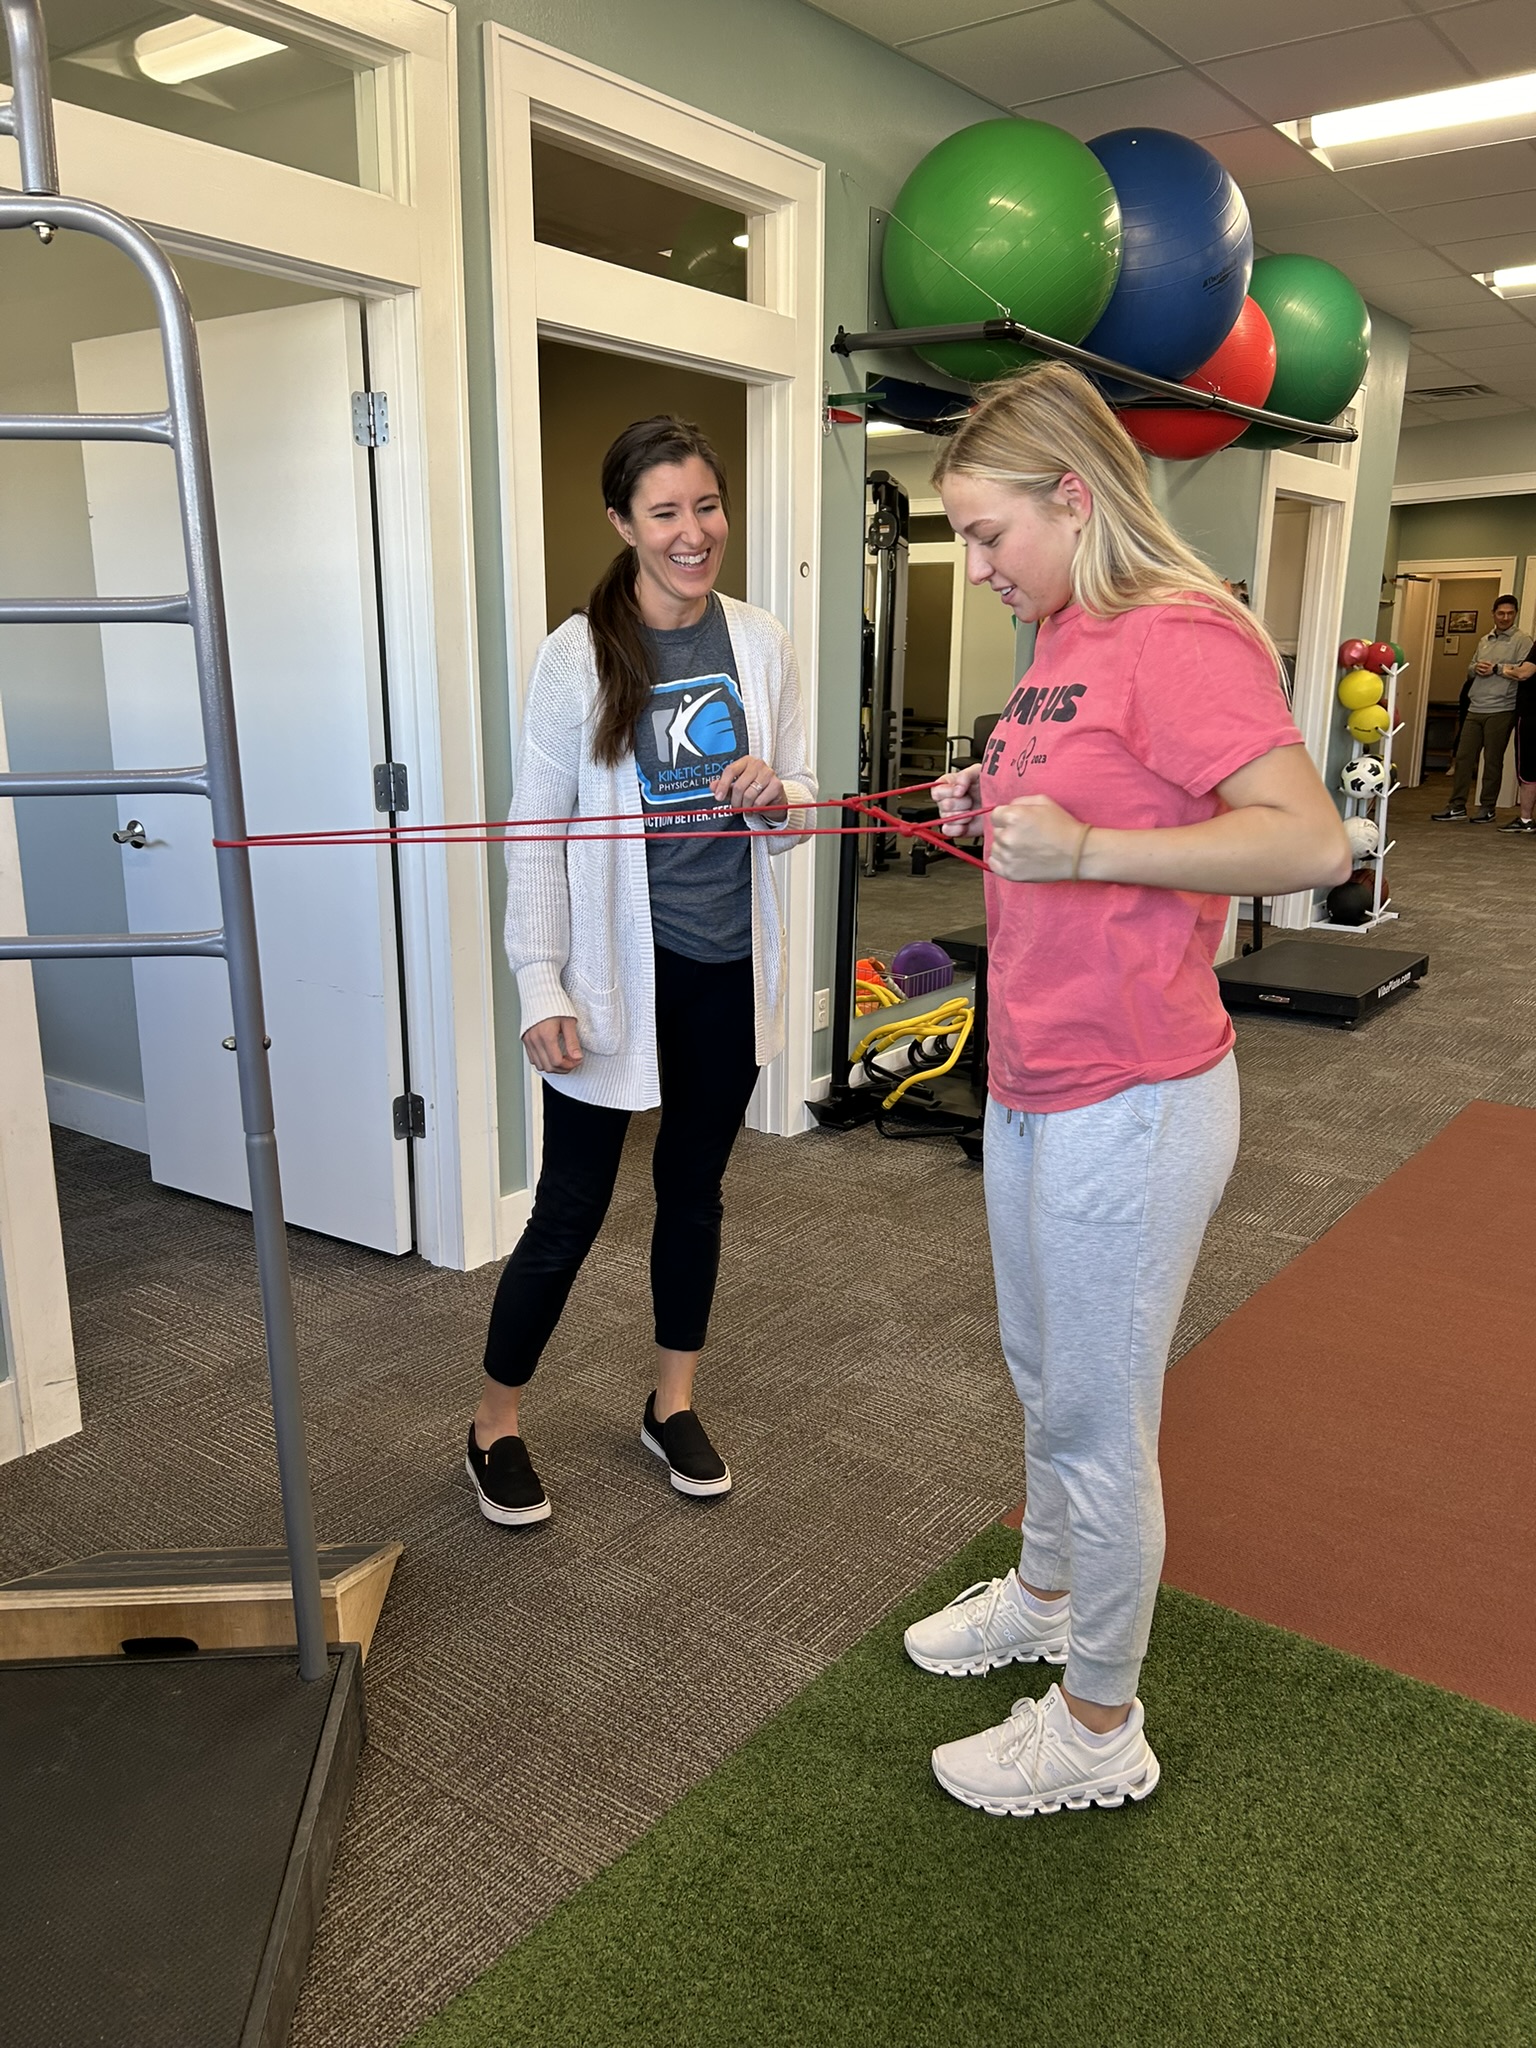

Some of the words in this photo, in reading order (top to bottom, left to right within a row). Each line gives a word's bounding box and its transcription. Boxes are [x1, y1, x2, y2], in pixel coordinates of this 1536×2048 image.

[1000, 683, 1088, 725] AMPUS
[658, 765, 702, 782] KINETIC
[658, 780, 699, 792] PHYSICAL
